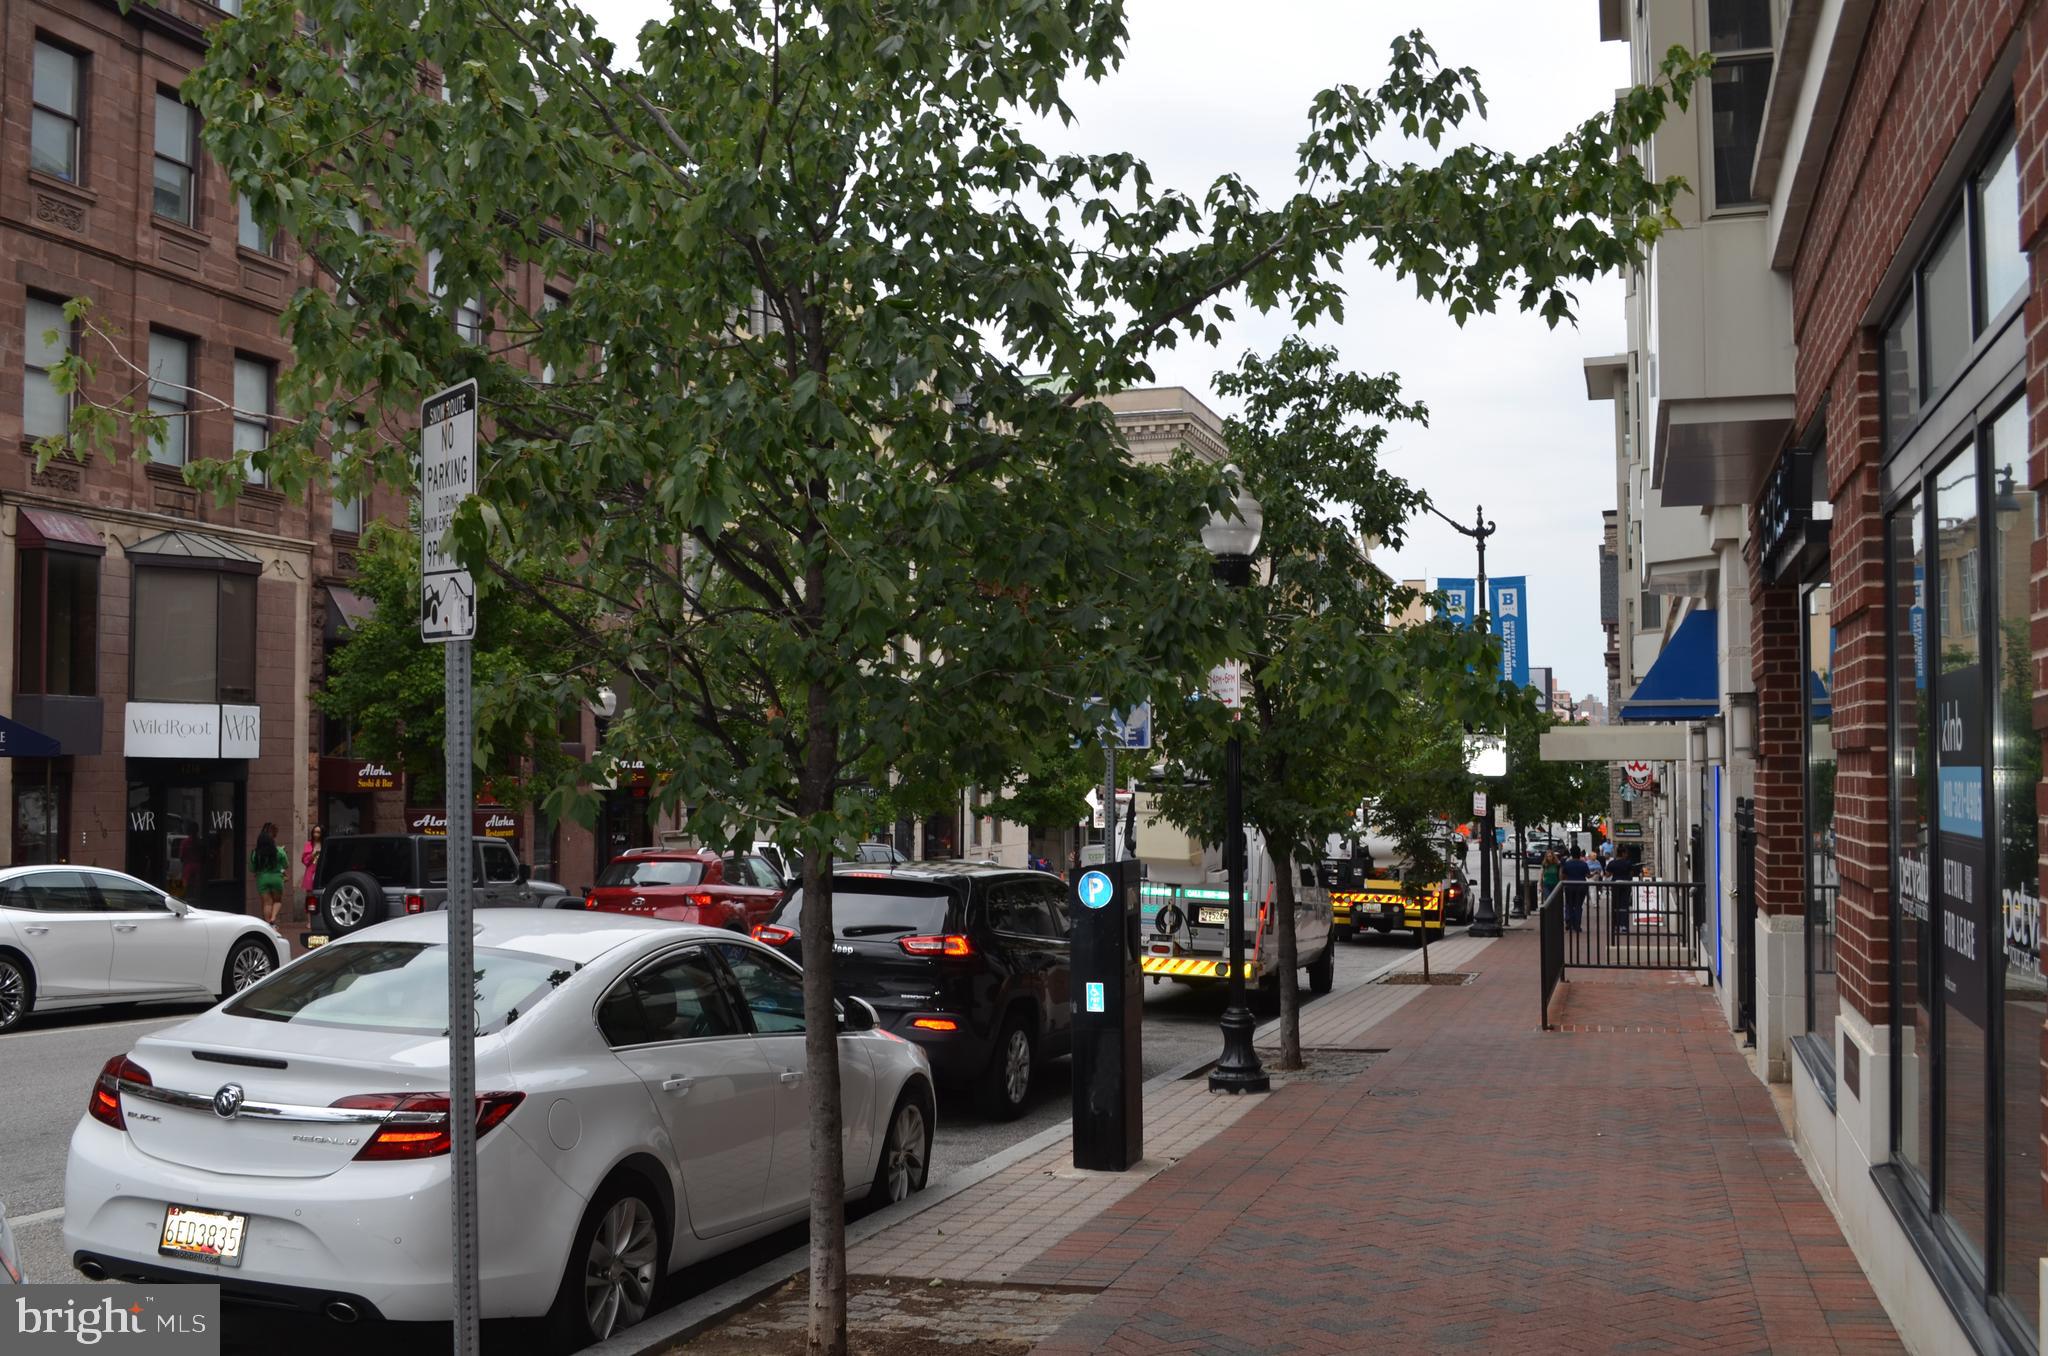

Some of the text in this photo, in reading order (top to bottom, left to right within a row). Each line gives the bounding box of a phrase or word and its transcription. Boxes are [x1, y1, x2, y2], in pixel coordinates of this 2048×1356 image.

[429, 393, 467, 425] SNOW ROUTE
[441, 421, 455, 453] NO
[427, 455, 468, 494] PARKING
[1450, 594, 1462, 606] B
[1502, 593, 1514, 605] B
[1502, 620, 1512, 681] BALTIMORE
[224, 713, 257, 741] WR
[1941, 699, 1963, 752] klnb
[131, 811, 156, 832] WR
[211, 810, 233, 830] WR
[485, 814, 515, 828] Aloha
[1943, 858, 1964, 900] RETAIL
[832, 943, 854, 955] Jeep
[1943, 910, 1975, 961] FOR LEASE
[127, 1110, 162, 1123] BUICK
[165, 1219, 240, 1251] 6ED3835
